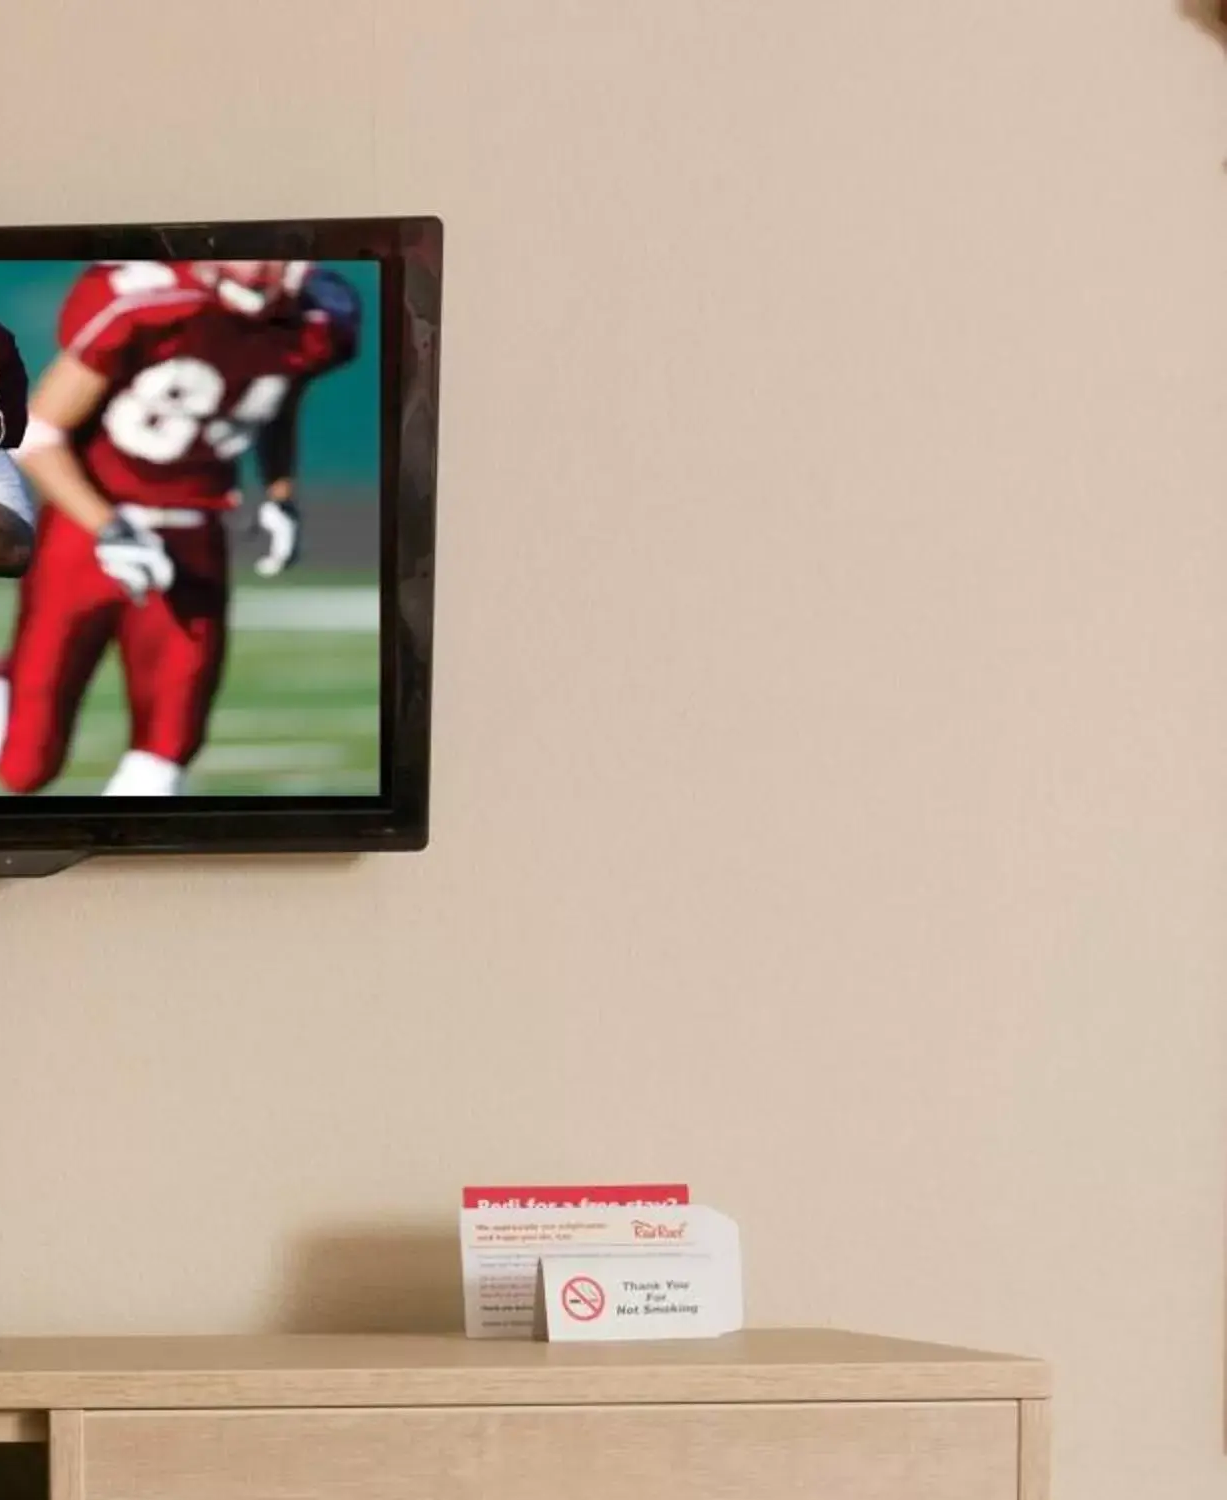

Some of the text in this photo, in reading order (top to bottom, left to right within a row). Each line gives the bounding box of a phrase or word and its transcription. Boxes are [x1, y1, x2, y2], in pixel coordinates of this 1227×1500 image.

[622, 1280, 690, 1291] Thank You
[646, 1292, 666, 1301] For
[617, 1304, 699, 1315] Not Smoking
